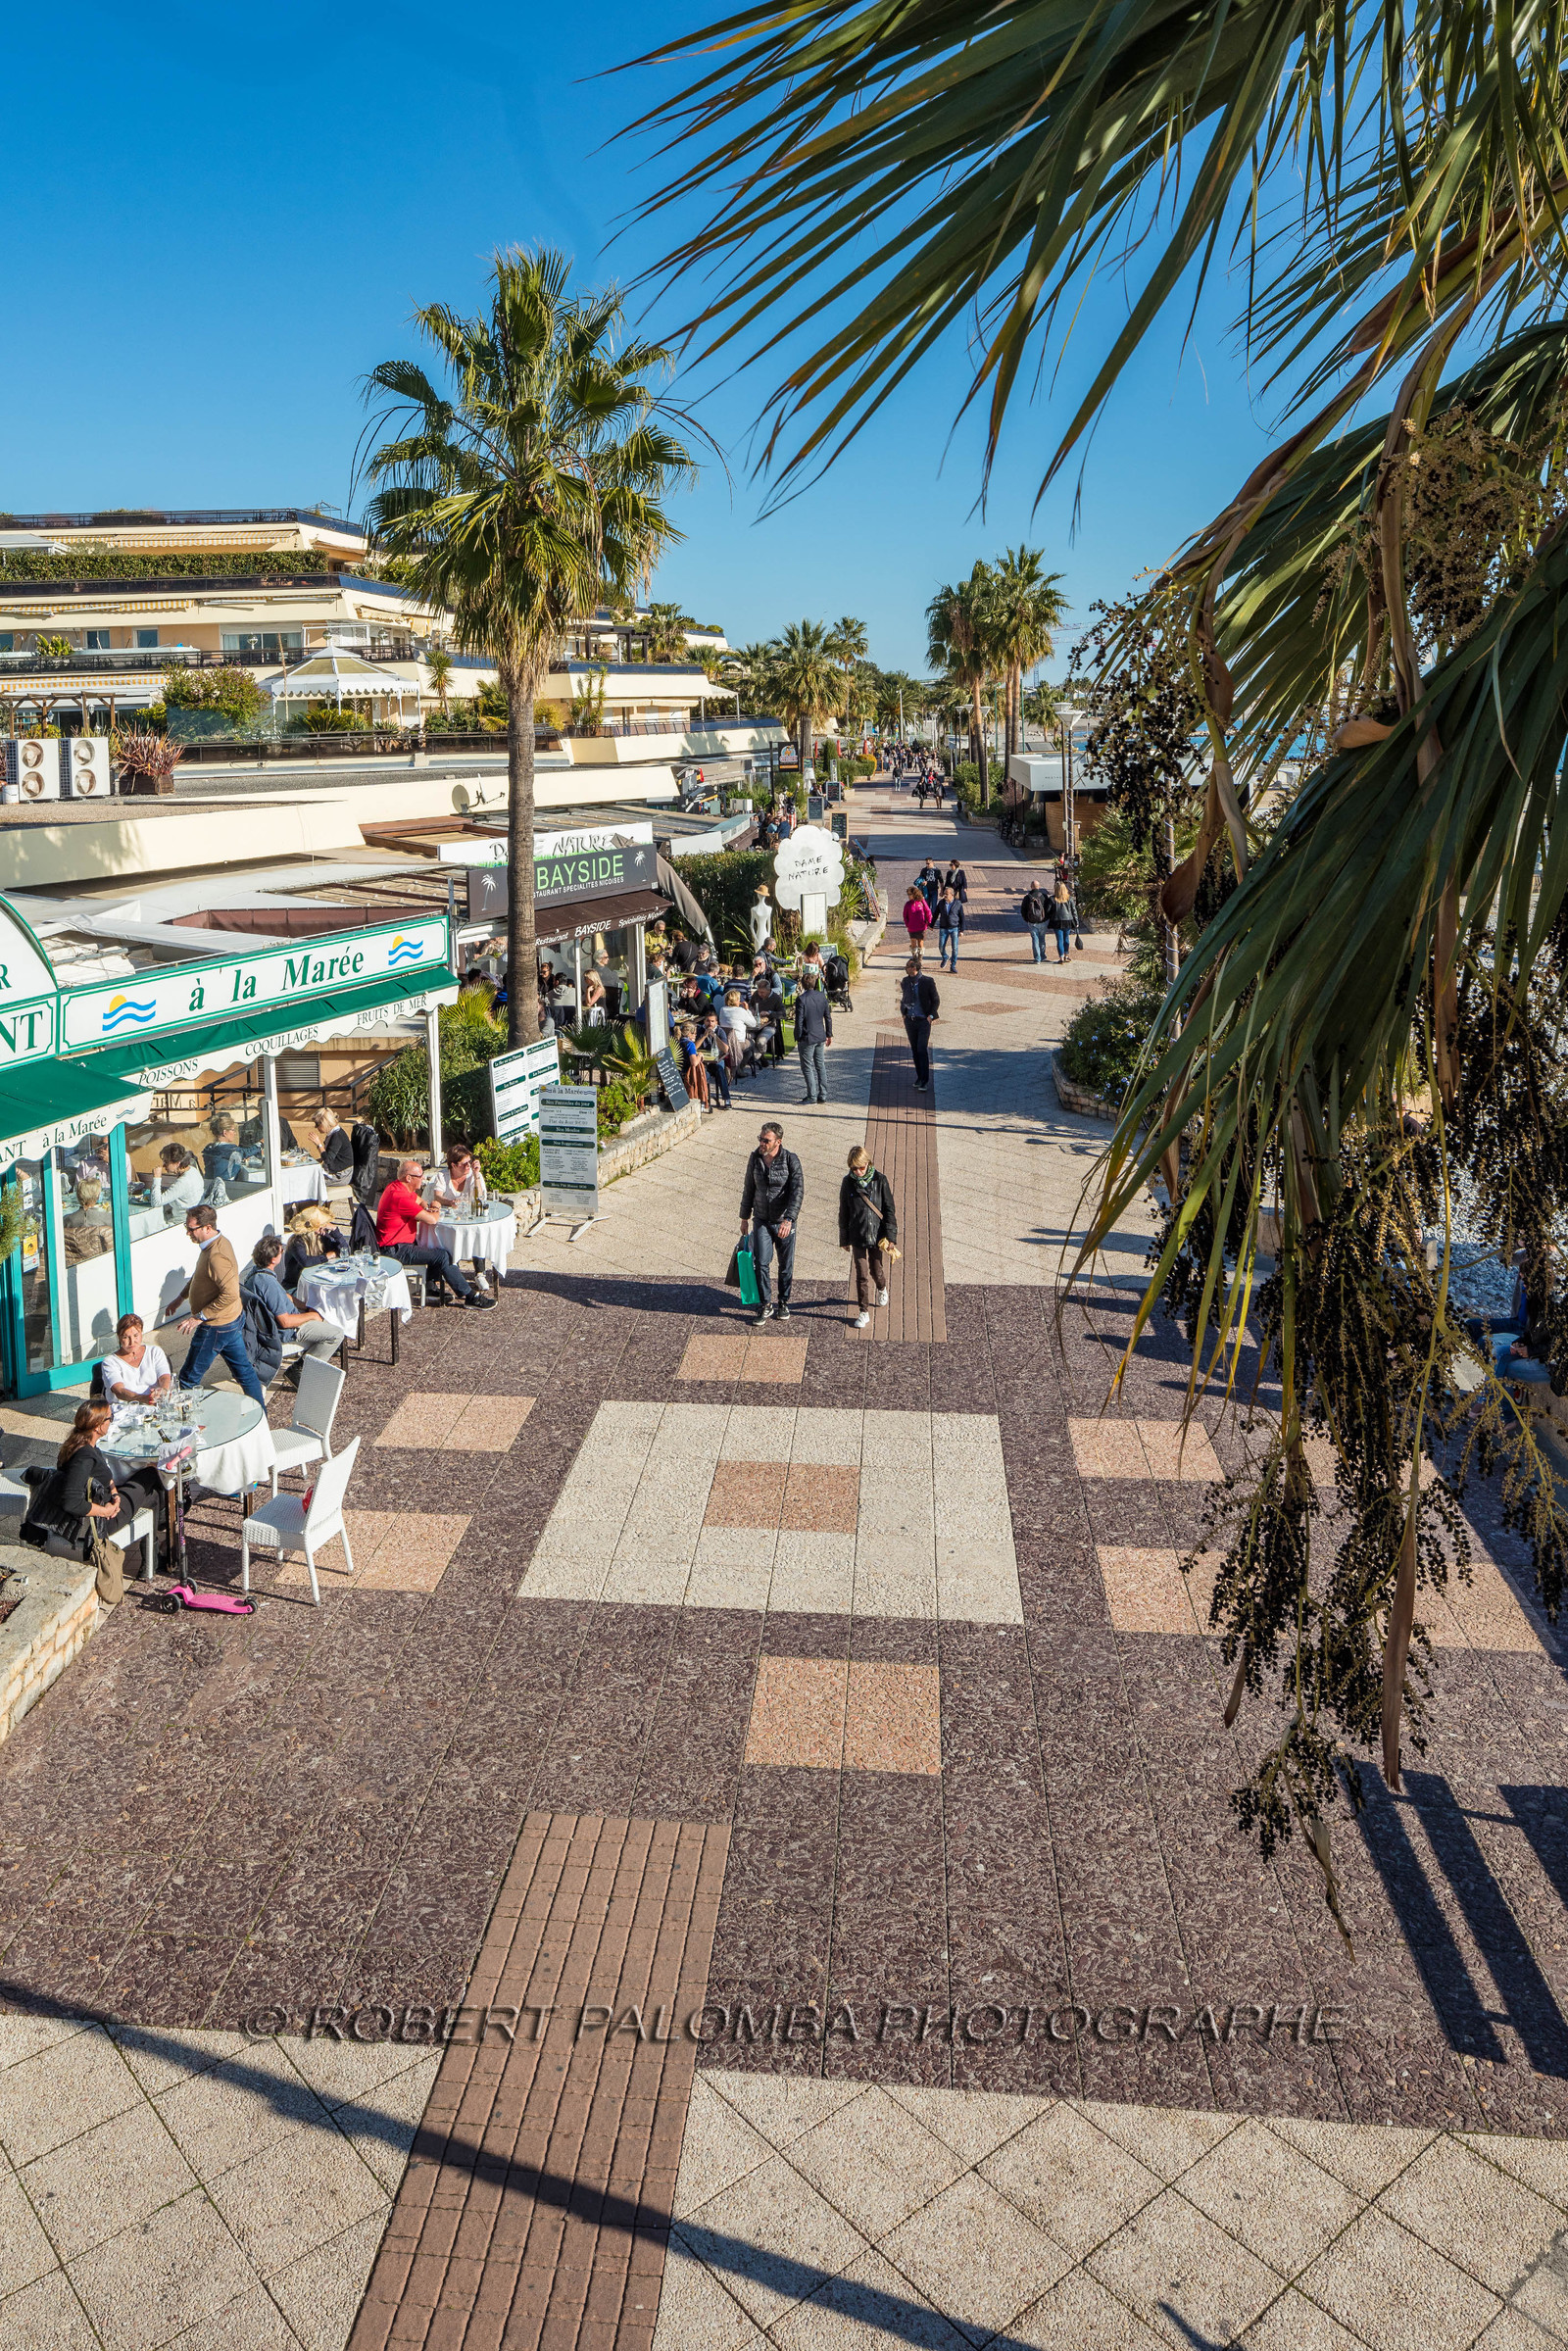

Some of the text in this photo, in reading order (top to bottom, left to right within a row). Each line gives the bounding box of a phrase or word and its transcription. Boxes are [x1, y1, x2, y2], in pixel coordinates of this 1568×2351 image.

[536, 854, 624, 891] BAYSIDE
[788, 866, 829, 881] NATURE
[794, 855, 823, 867] DAME
[533, 887, 563, 900] STAURANT
[563, 880, 599, 894] SPECIALITES
[535, 932, 569, 947] Restaurant
[574, 919, 612, 938] BAYSIDE
[188, 946, 365, 1012] à la Marée
[138, 996, 427, 1086] POISSONS COQUILLAGES FRUITS DE MER
[42, 1133, 50, 1149] à
[54, 1128, 65, 1144] la
[69, 1114, 107, 1139] Marée
